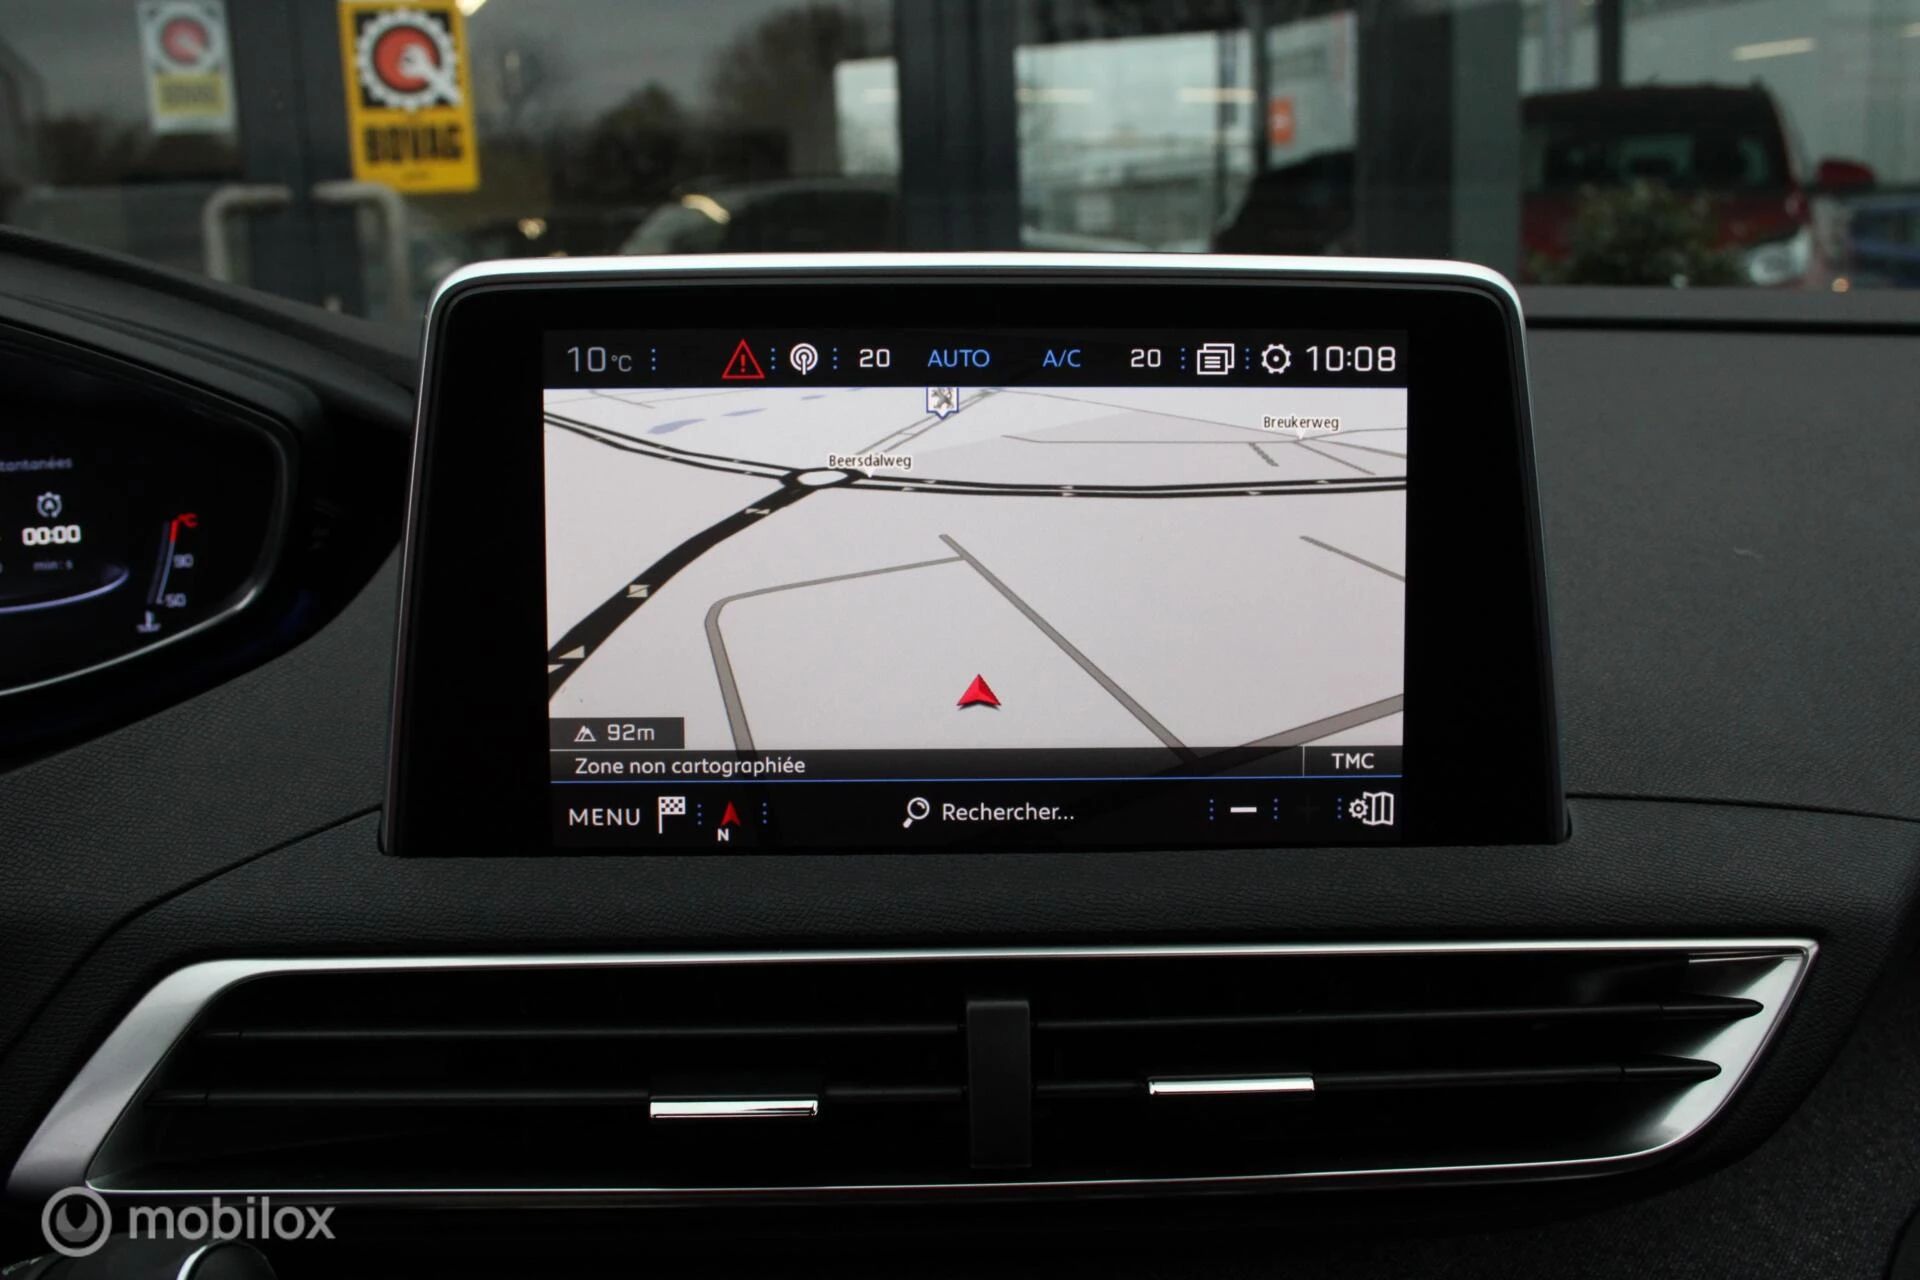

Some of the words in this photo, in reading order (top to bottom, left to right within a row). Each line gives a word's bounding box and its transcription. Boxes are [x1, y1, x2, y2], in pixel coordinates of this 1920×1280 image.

[859, 348, 891, 368] 20
[927, 348, 991, 368] AUTO
[1041, 348, 1081, 368] A/C
[1130, 348, 1162, 368] 20
[1305, 345, 1397, 372] 10:08
[1263, 414, 1340, 431] Breukerweg
[828, 454, 912, 470] Beersdalweg
[21, 524, 82, 546] 00:00
[606, 724, 656, 741] 92m
[575, 757, 624, 775] Zone
[629, 761, 666, 774] non
[671, 756, 806, 778] cartographiée
[1331, 752, 1375, 769] TMC
[568, 808, 641, 827] MENU
[942, 802, 1075, 821] Rechercher...
[716, 828, 730, 842] N
